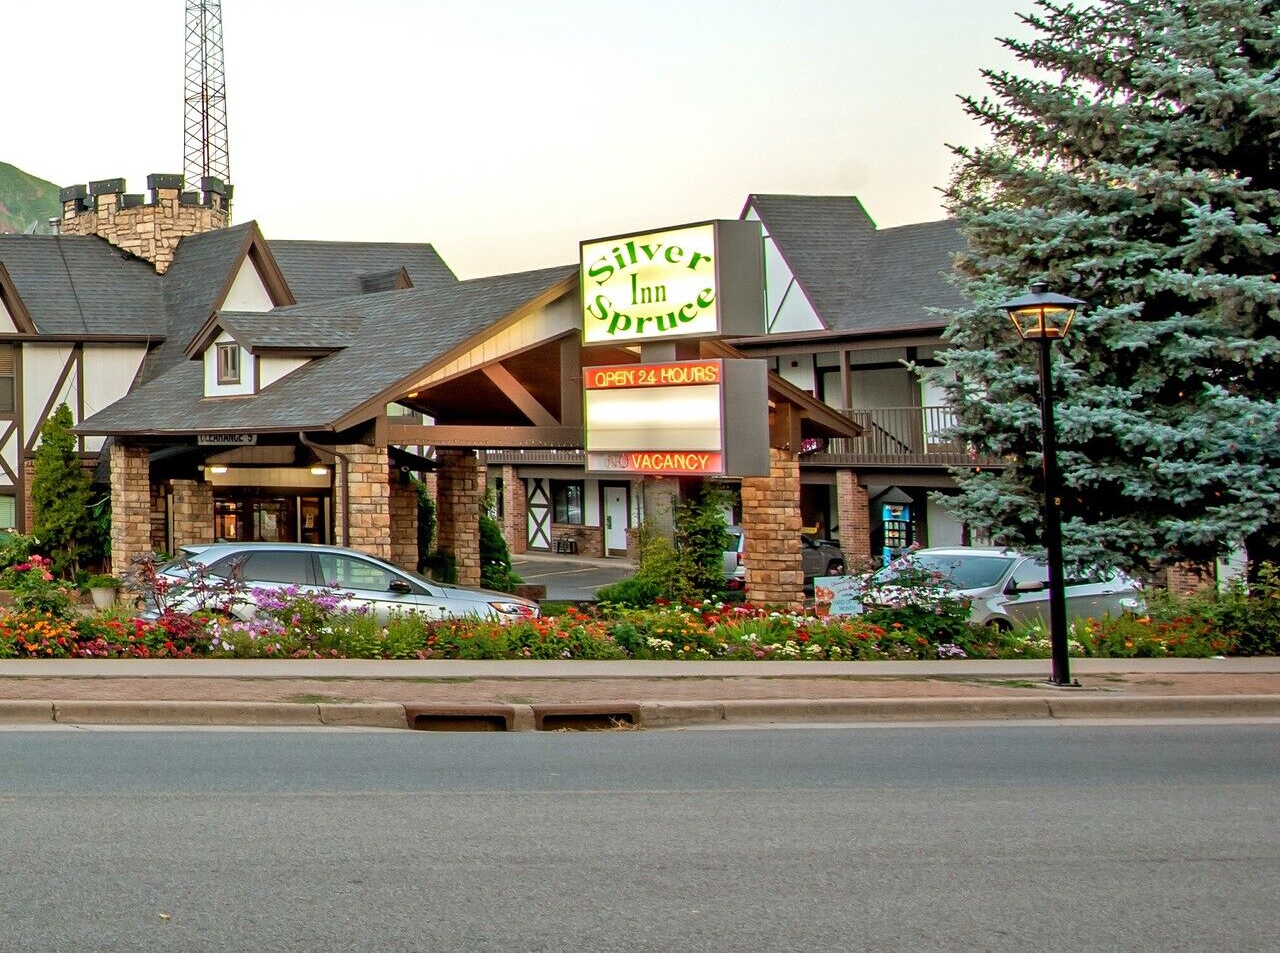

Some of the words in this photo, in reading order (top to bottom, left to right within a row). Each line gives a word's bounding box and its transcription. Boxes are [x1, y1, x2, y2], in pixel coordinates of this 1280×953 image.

[588, 241, 712, 286] Silver
[630, 273, 667, 305] Inn
[587, 288, 716, 335] Spruce
[595, 370, 636, 387] OPEN
[638, 370, 658, 385] 24
[660, 366, 718, 384] HOURS
[631, 453, 709, 470] VACANCY
